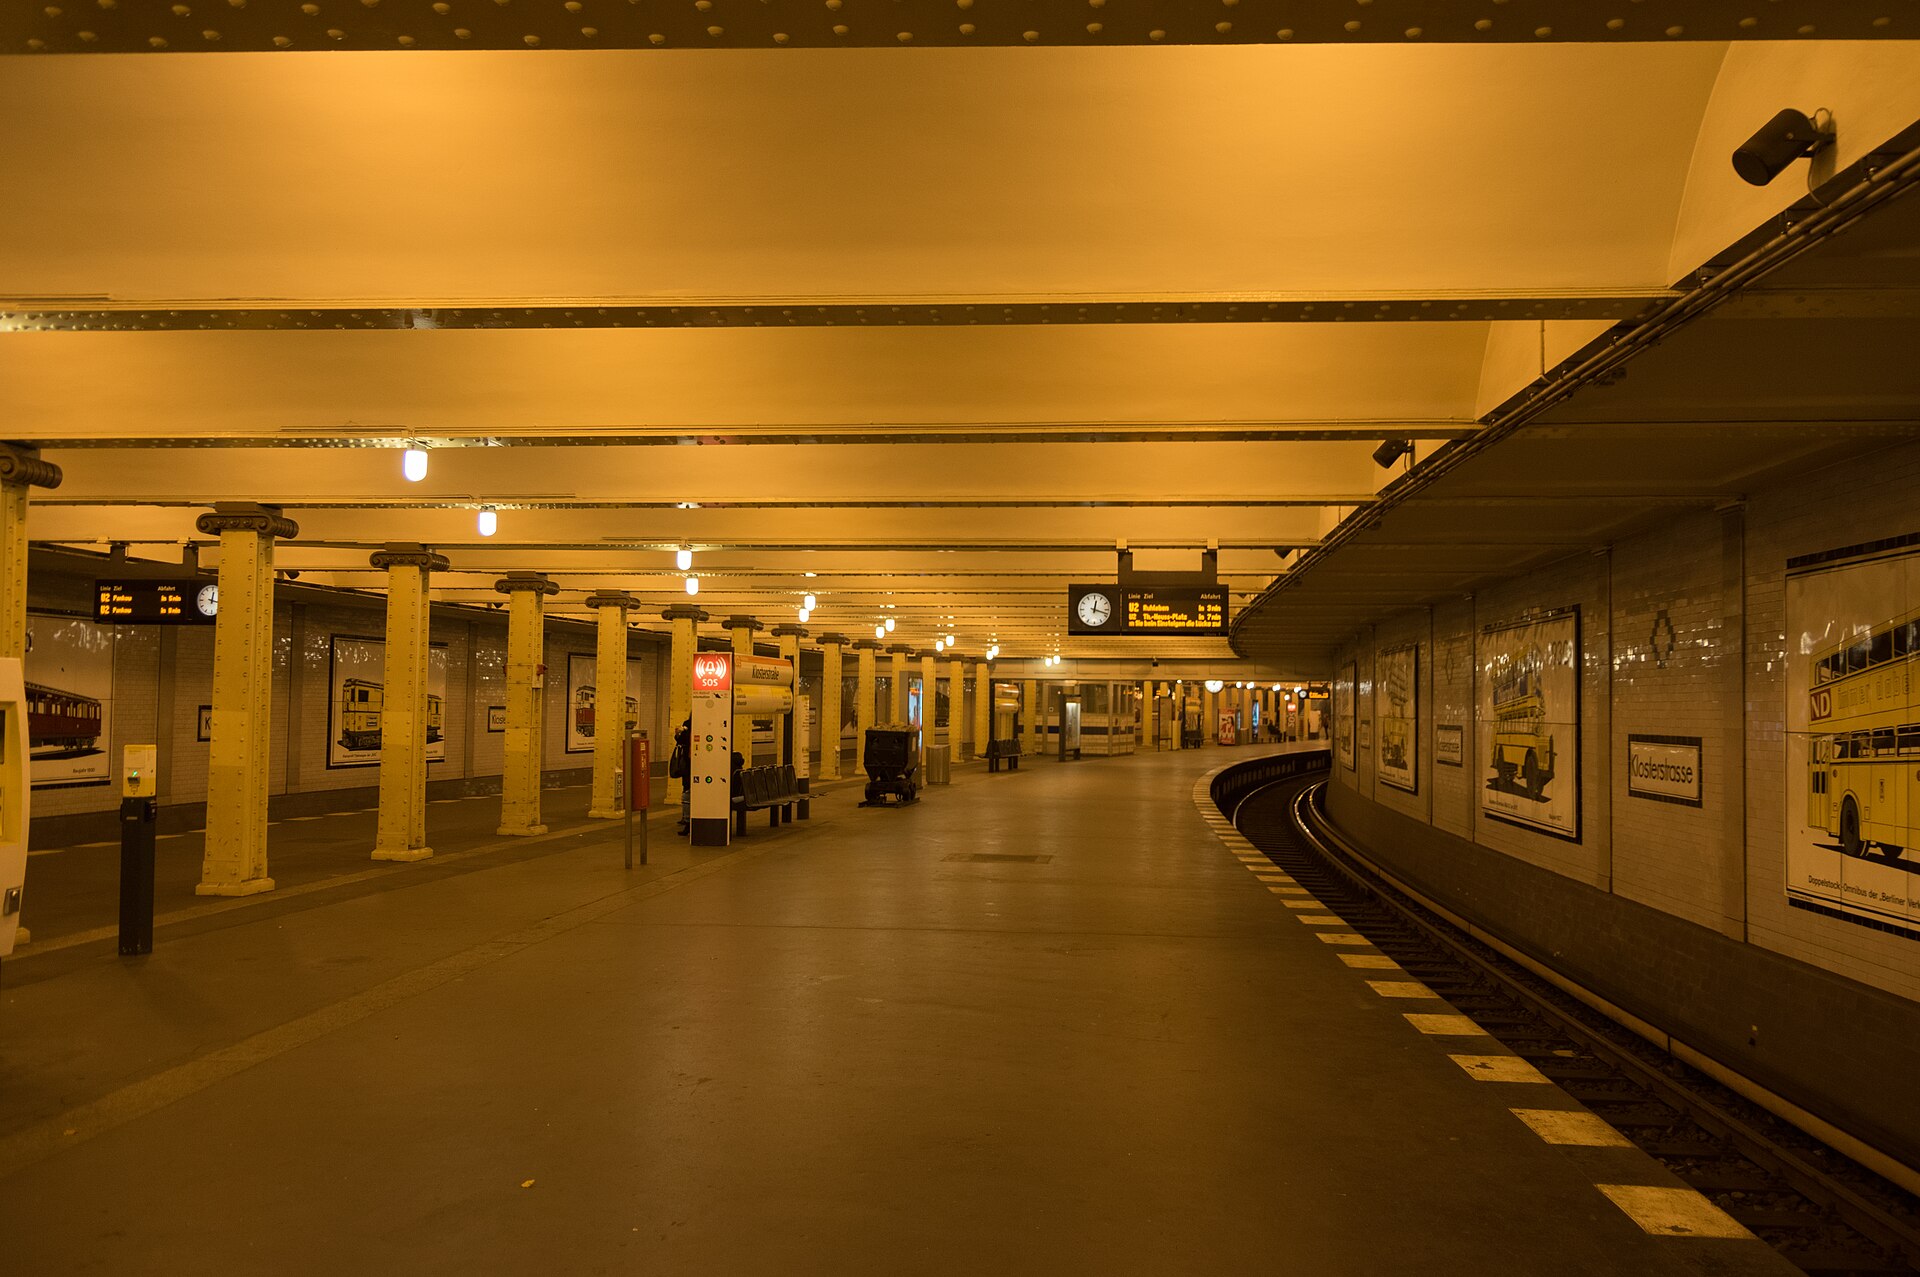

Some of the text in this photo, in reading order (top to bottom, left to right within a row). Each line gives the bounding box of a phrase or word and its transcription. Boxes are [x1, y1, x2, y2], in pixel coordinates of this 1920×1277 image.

[113, 584, 123, 592] Ziel
[100, 593, 111, 603] U2
[1143, 592, 1154, 600] Ziel
[100, 604, 110, 615] U2
[112, 606, 133, 614] Pankow
[1128, 602, 1140, 613] U2
[1142, 604, 1170, 612] Ruhleben
[1128, 613, 1137, 621] U2
[702, 678, 719, 687] SOS
[1810, 691, 1832, 719] ND
[1631, 754, 1694, 784] Klosterstrasse
